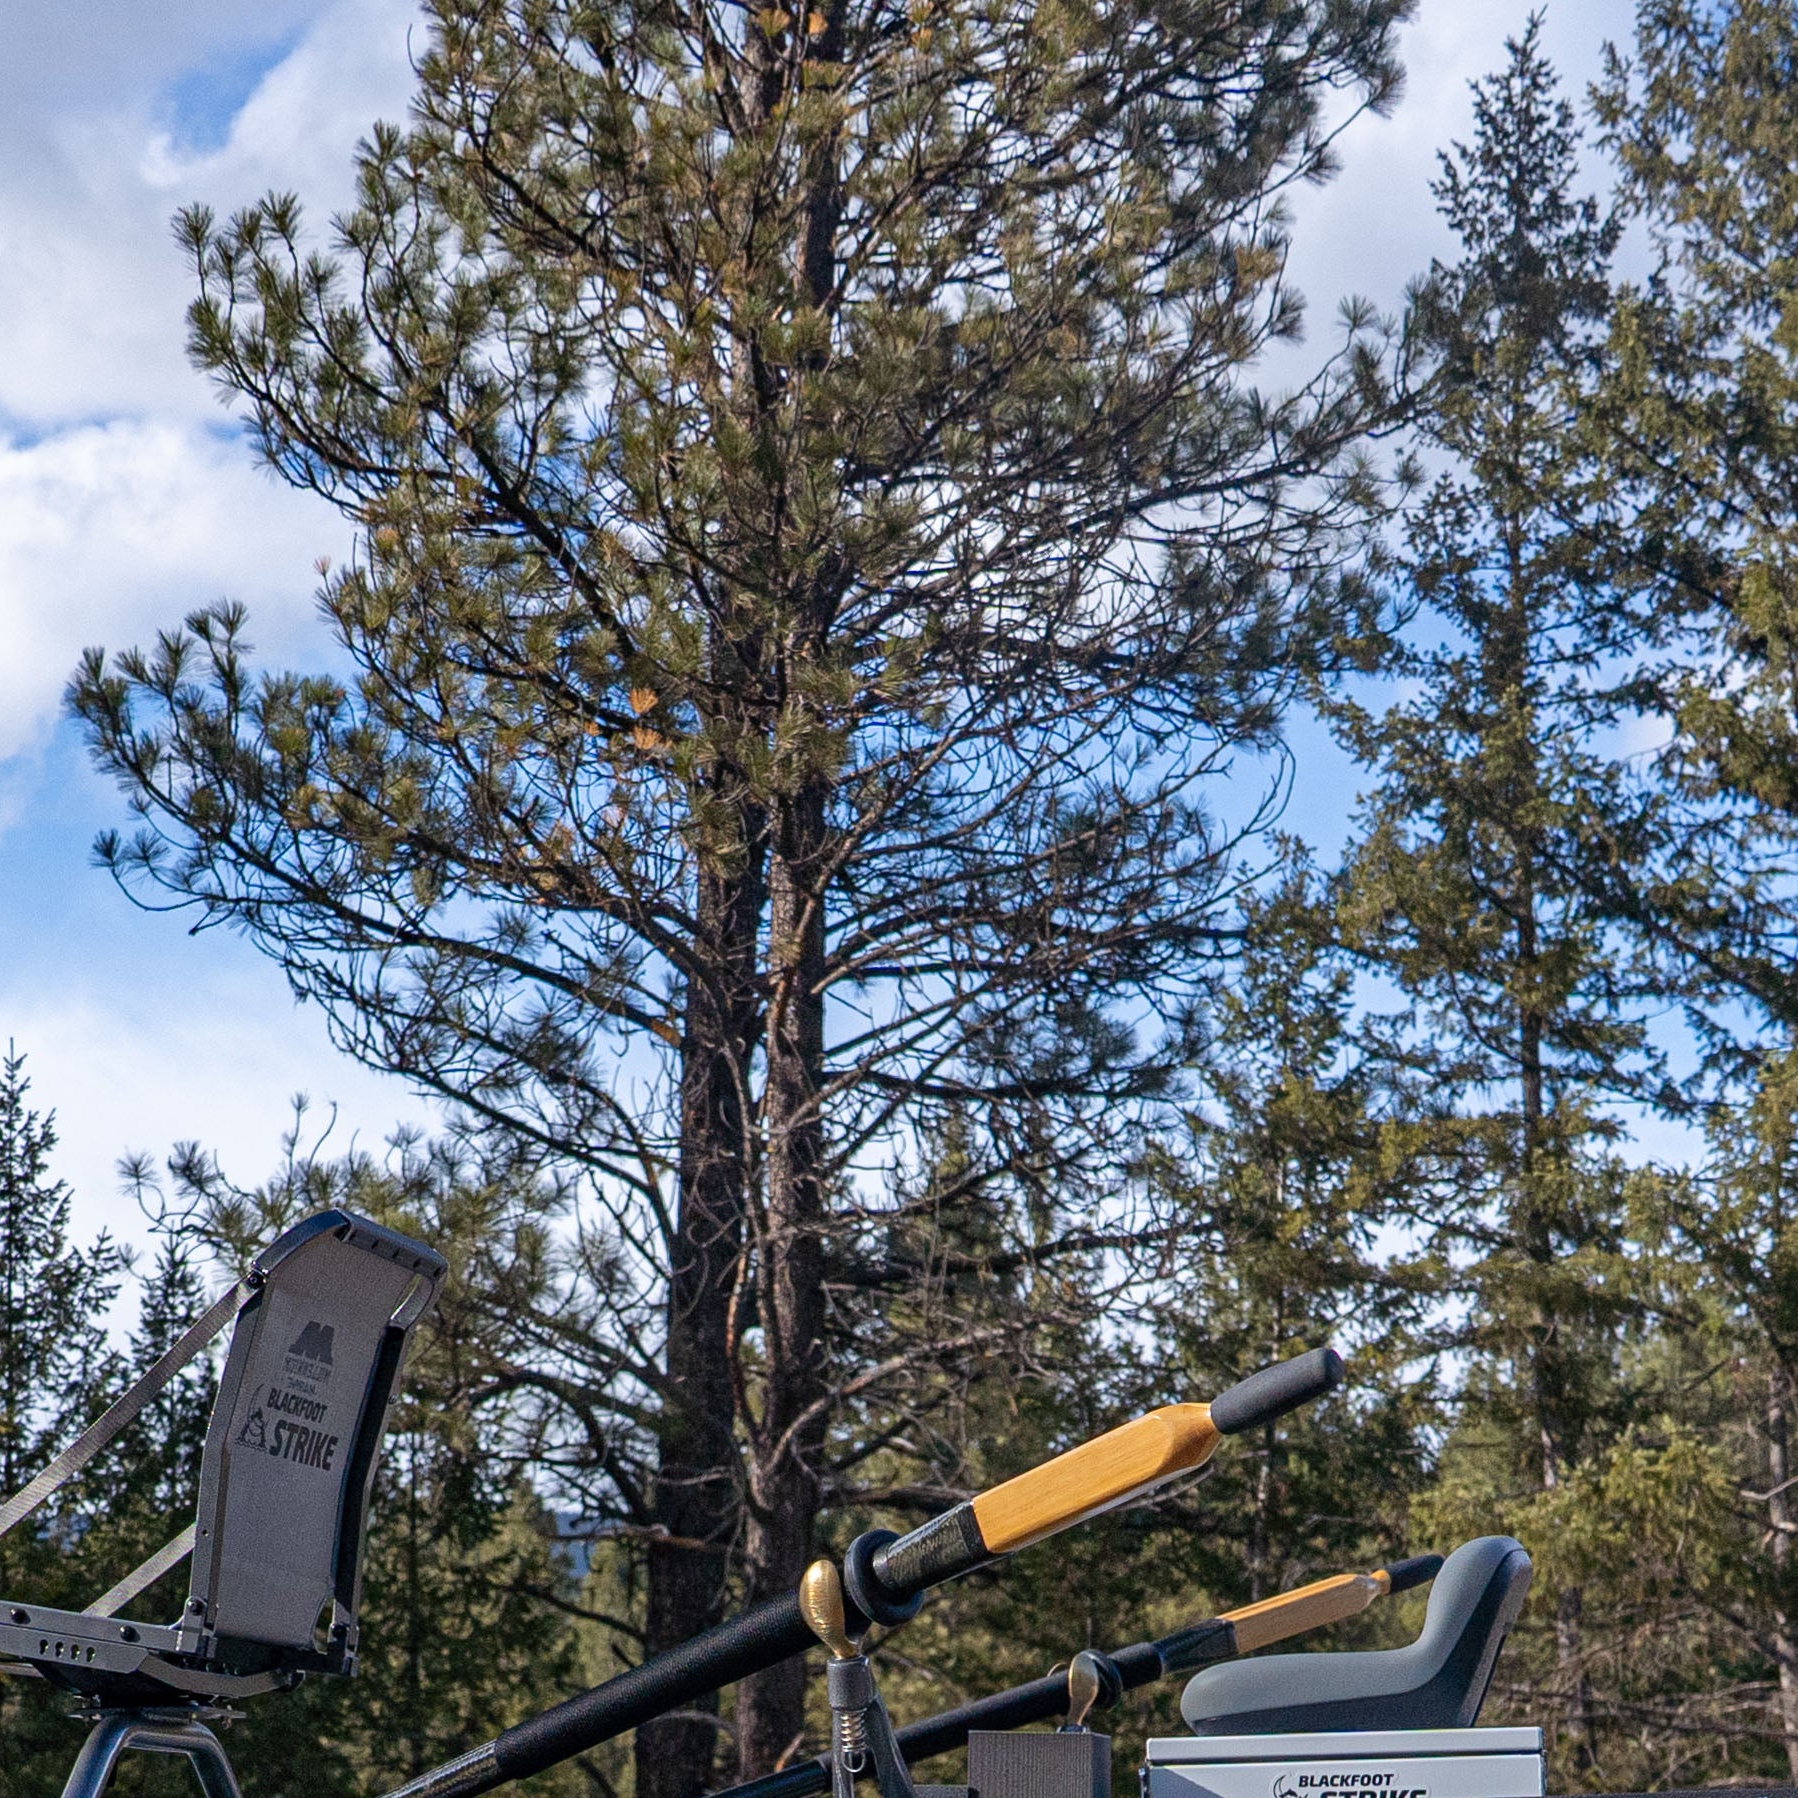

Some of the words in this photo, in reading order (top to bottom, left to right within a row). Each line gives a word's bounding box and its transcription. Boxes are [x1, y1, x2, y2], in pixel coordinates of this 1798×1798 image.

[267, 1387, 328, 1423] BLACKFOOT
[269, 1419, 339, 1471] STRIKE
[1298, 1773, 1395, 1788] BLACKFOOT
